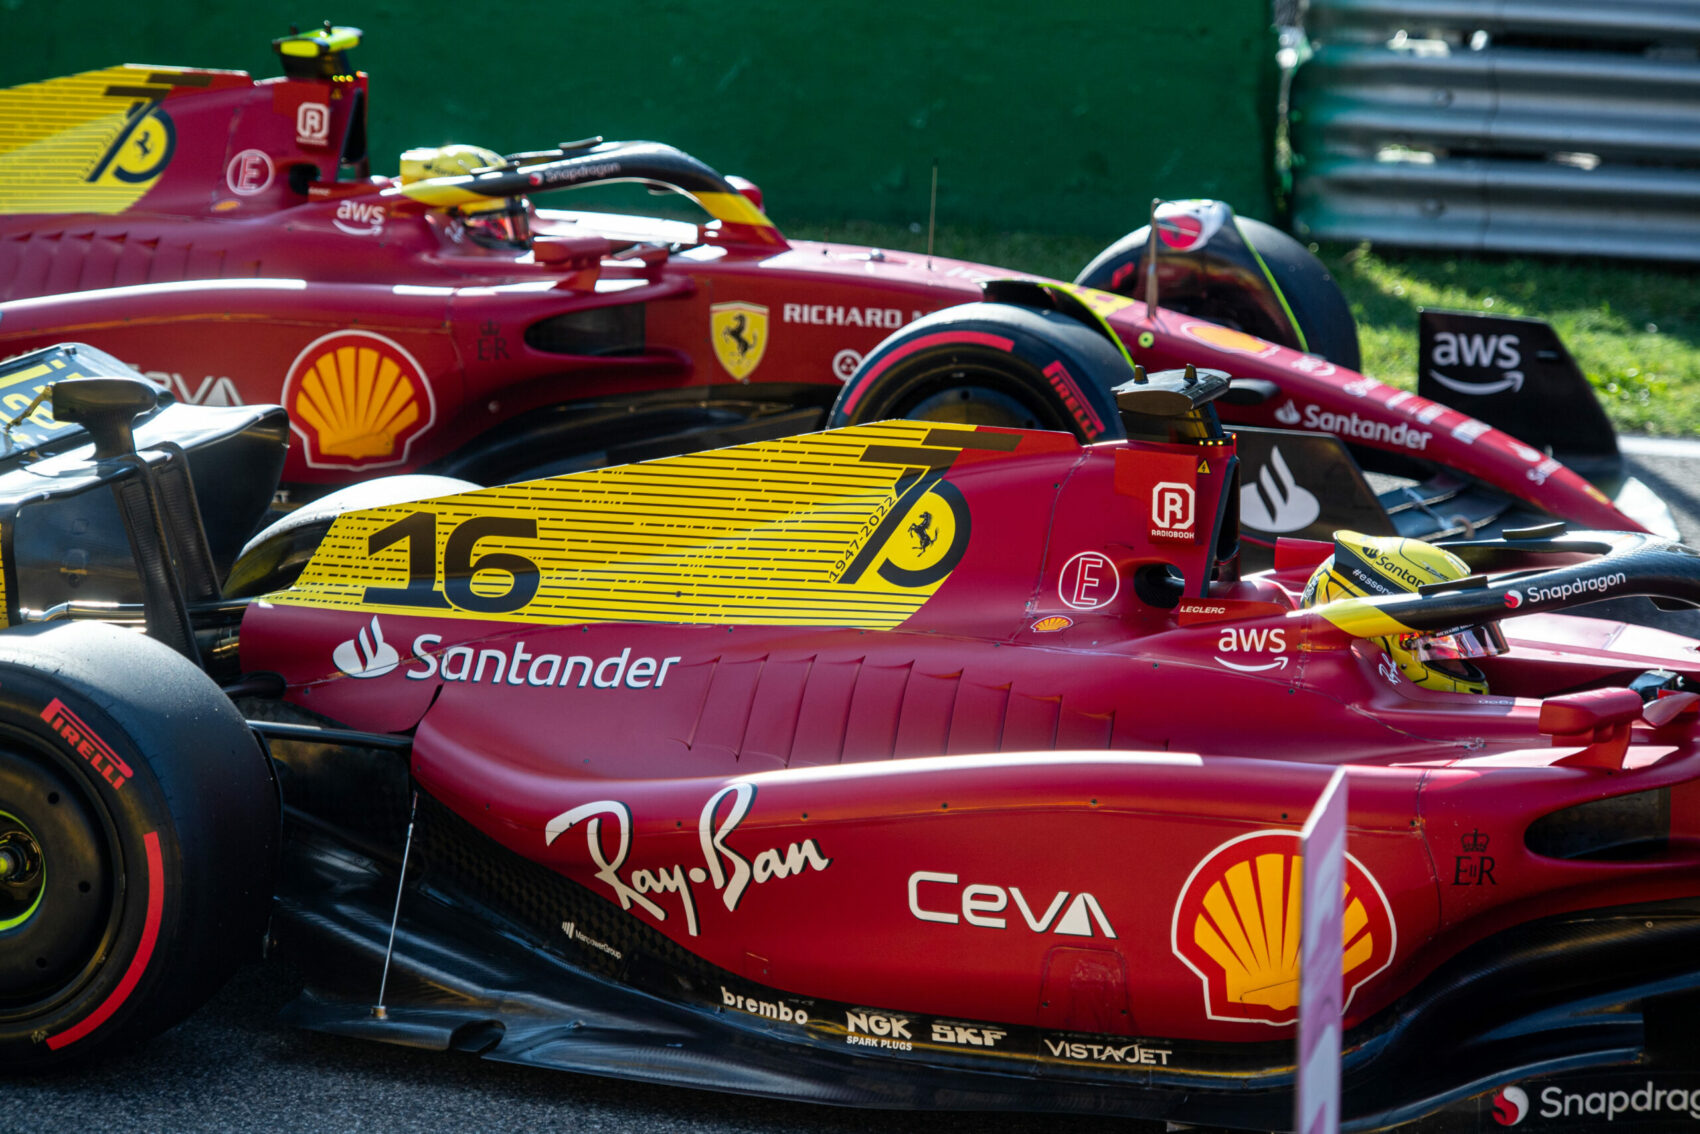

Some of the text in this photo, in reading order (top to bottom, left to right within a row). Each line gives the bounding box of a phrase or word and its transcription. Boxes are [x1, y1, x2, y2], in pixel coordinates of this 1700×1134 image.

[546, 161, 621, 183] Snapdragon
[337, 199, 385, 225] aws
[784, 303, 902, 328] RICHARD
[1432, 332, 1521, 369] aws
[127, 363, 244, 407] VA
[1042, 360, 1105, 439] PIRELLI
[1303, 404, 1433, 450] Santander
[828, 496, 896, 582] 1947-2022
[1151, 529, 1195, 539] RADIOBOOK
[362, 511, 541, 613] 16
[1072, 557, 1103, 605] E
[1527, 572, 1626, 603] Snapdragon
[1180, 605, 1226, 614] LECLERC
[1218, 628, 1287, 654] aws
[406, 633, 681, 689] Santander
[40, 697, 134, 790] PIRELLI
[720, 986, 808, 1025] brembo
[846, 1011, 912, 1040] NGK
[846, 1034, 913, 1051] SPARK PLUGS
[931, 1023, 1007, 1047] SKF
